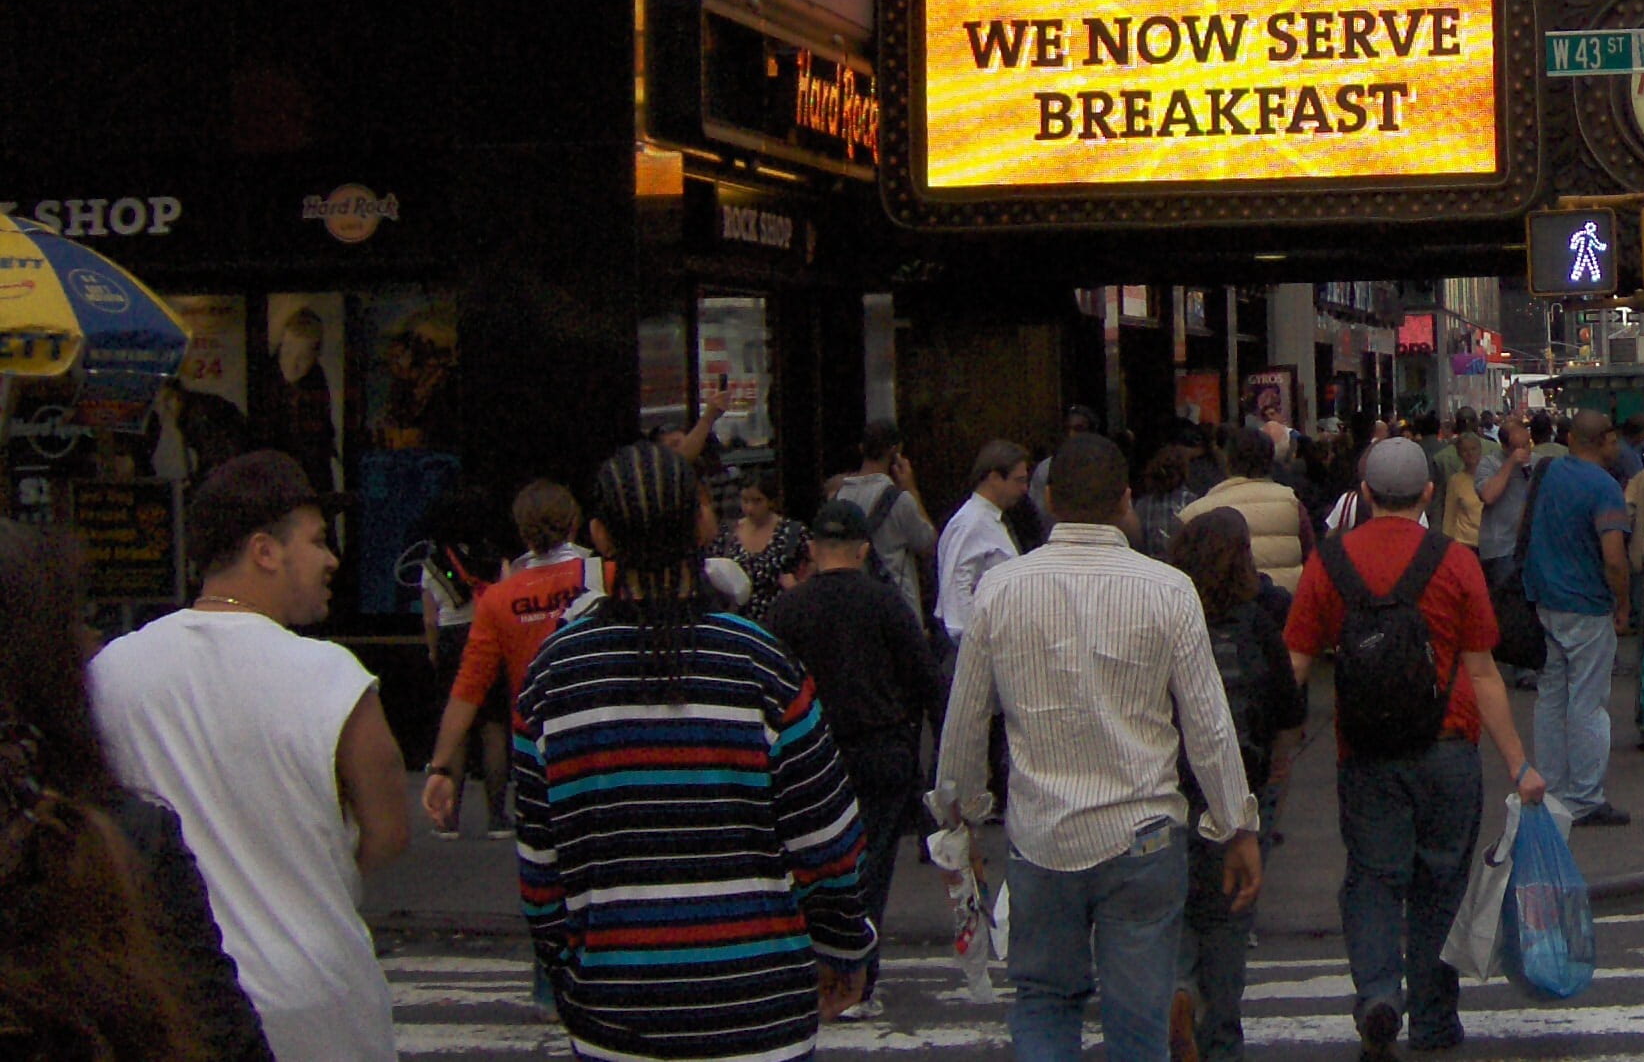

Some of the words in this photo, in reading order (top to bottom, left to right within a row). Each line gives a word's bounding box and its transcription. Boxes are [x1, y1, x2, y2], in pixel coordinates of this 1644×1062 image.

[963, 19, 1082, 70] WE
[1083, 13, 1249, 66] NOW
[1266, 8, 1461, 62] SERVE
[1553, 39, 1571, 70] W
[1575, 37, 1601, 69] 43
[1607, 36, 1626, 55] ST
[1034, 82, 1409, 142] BREAKFAST
[34, 195, 183, 236] SHOP
[303, 194, 351, 220] Hard
[353, 190, 400, 221] Rock
